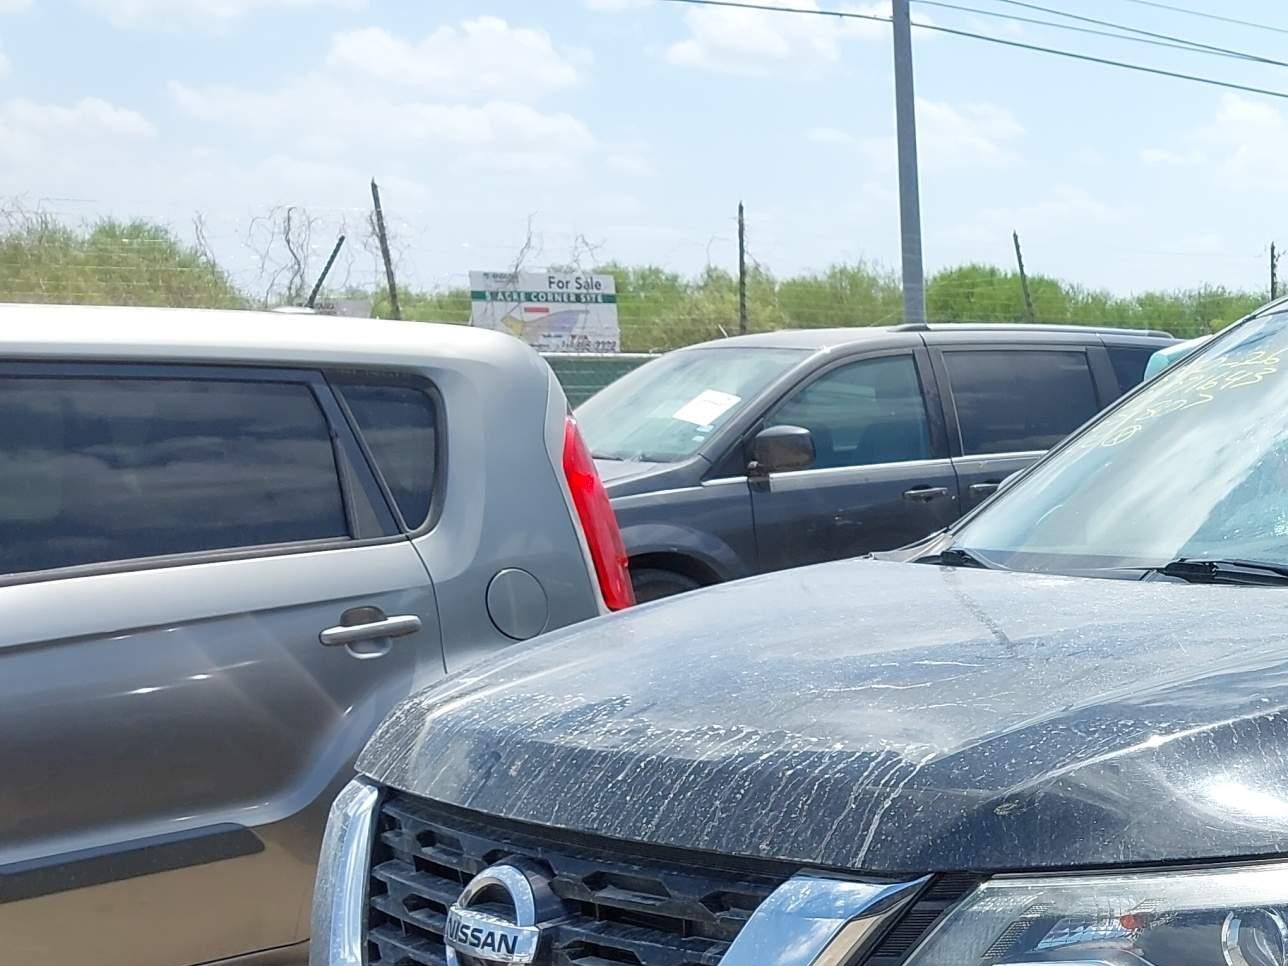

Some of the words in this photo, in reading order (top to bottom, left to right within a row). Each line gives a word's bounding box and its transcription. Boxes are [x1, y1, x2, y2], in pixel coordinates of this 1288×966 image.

[548, 276, 571, 289] For
[575, 276, 602, 290] Sale
[497, 291, 527, 301] ACRE
[530, 292, 578, 303] CORNER
[447, 915, 519, 955] NISSAN
